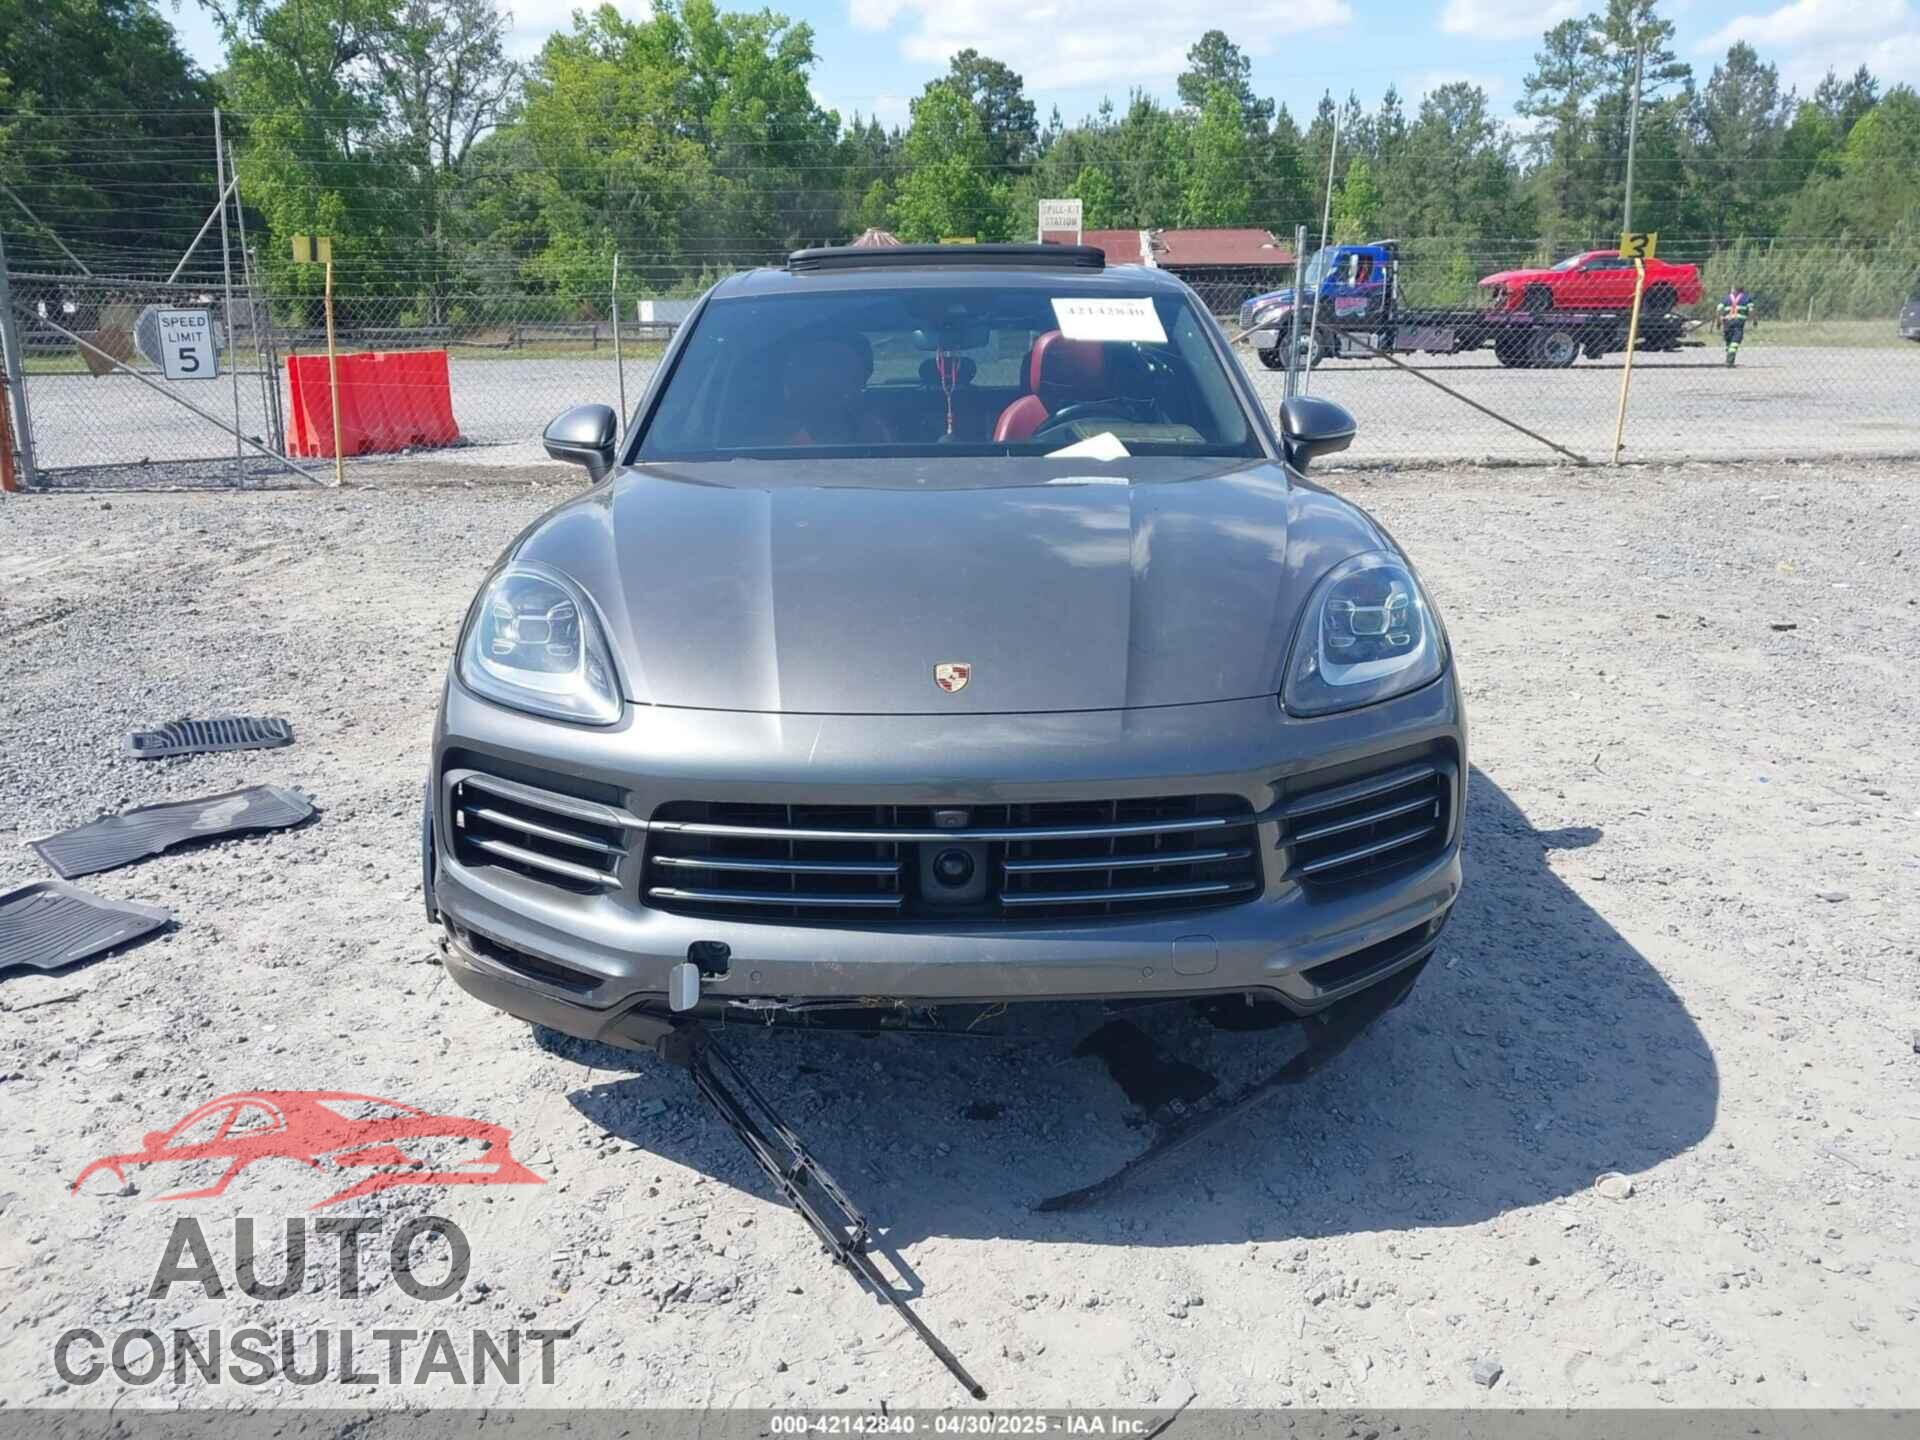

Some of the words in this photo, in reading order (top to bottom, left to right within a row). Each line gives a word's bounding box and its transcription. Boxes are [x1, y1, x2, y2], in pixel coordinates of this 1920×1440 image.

[1630, 234, 1649, 257] 3
[162, 316, 205, 328] SPEED
[168, 332, 202, 343] LIMIT
[179, 347, 200, 372] 5
